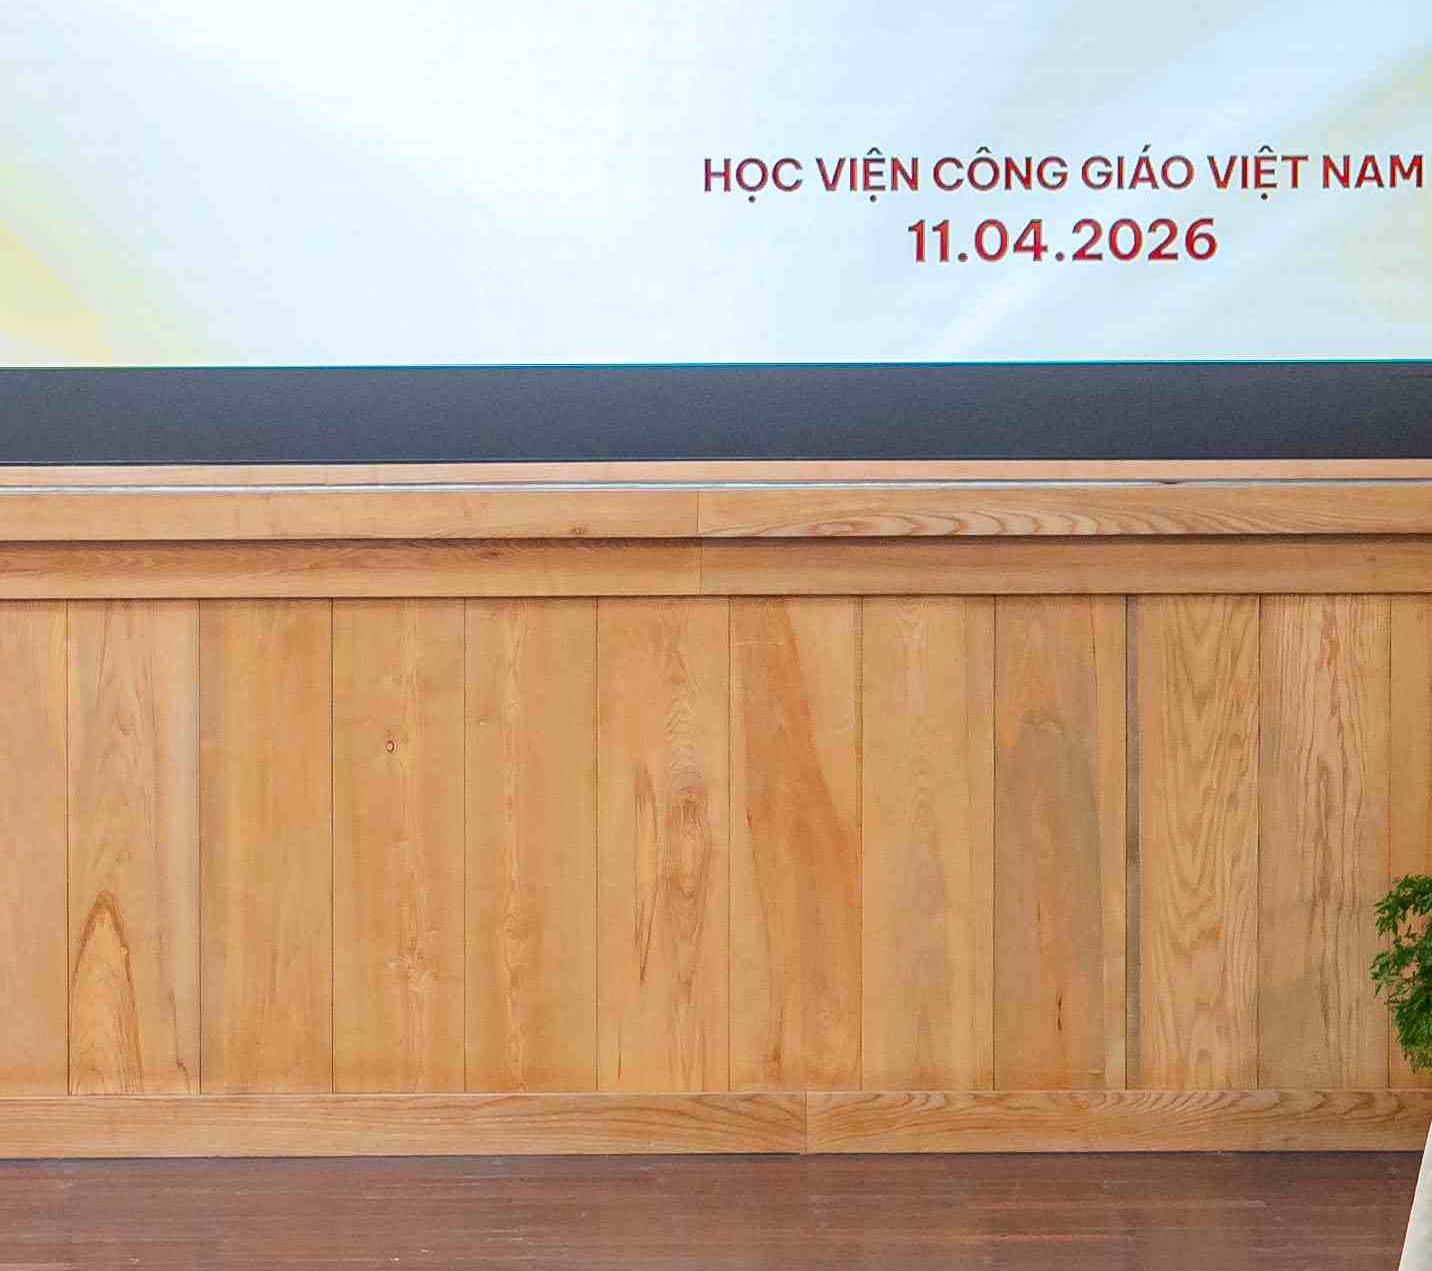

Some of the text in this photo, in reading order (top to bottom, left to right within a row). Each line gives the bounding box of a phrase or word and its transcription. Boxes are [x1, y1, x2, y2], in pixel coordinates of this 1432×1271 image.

[704, 144, 1424, 203] HỌC VIỆN CÔNG GIÁO VIỆT NAM
[907, 217, 1218, 263] 11.04.2026
